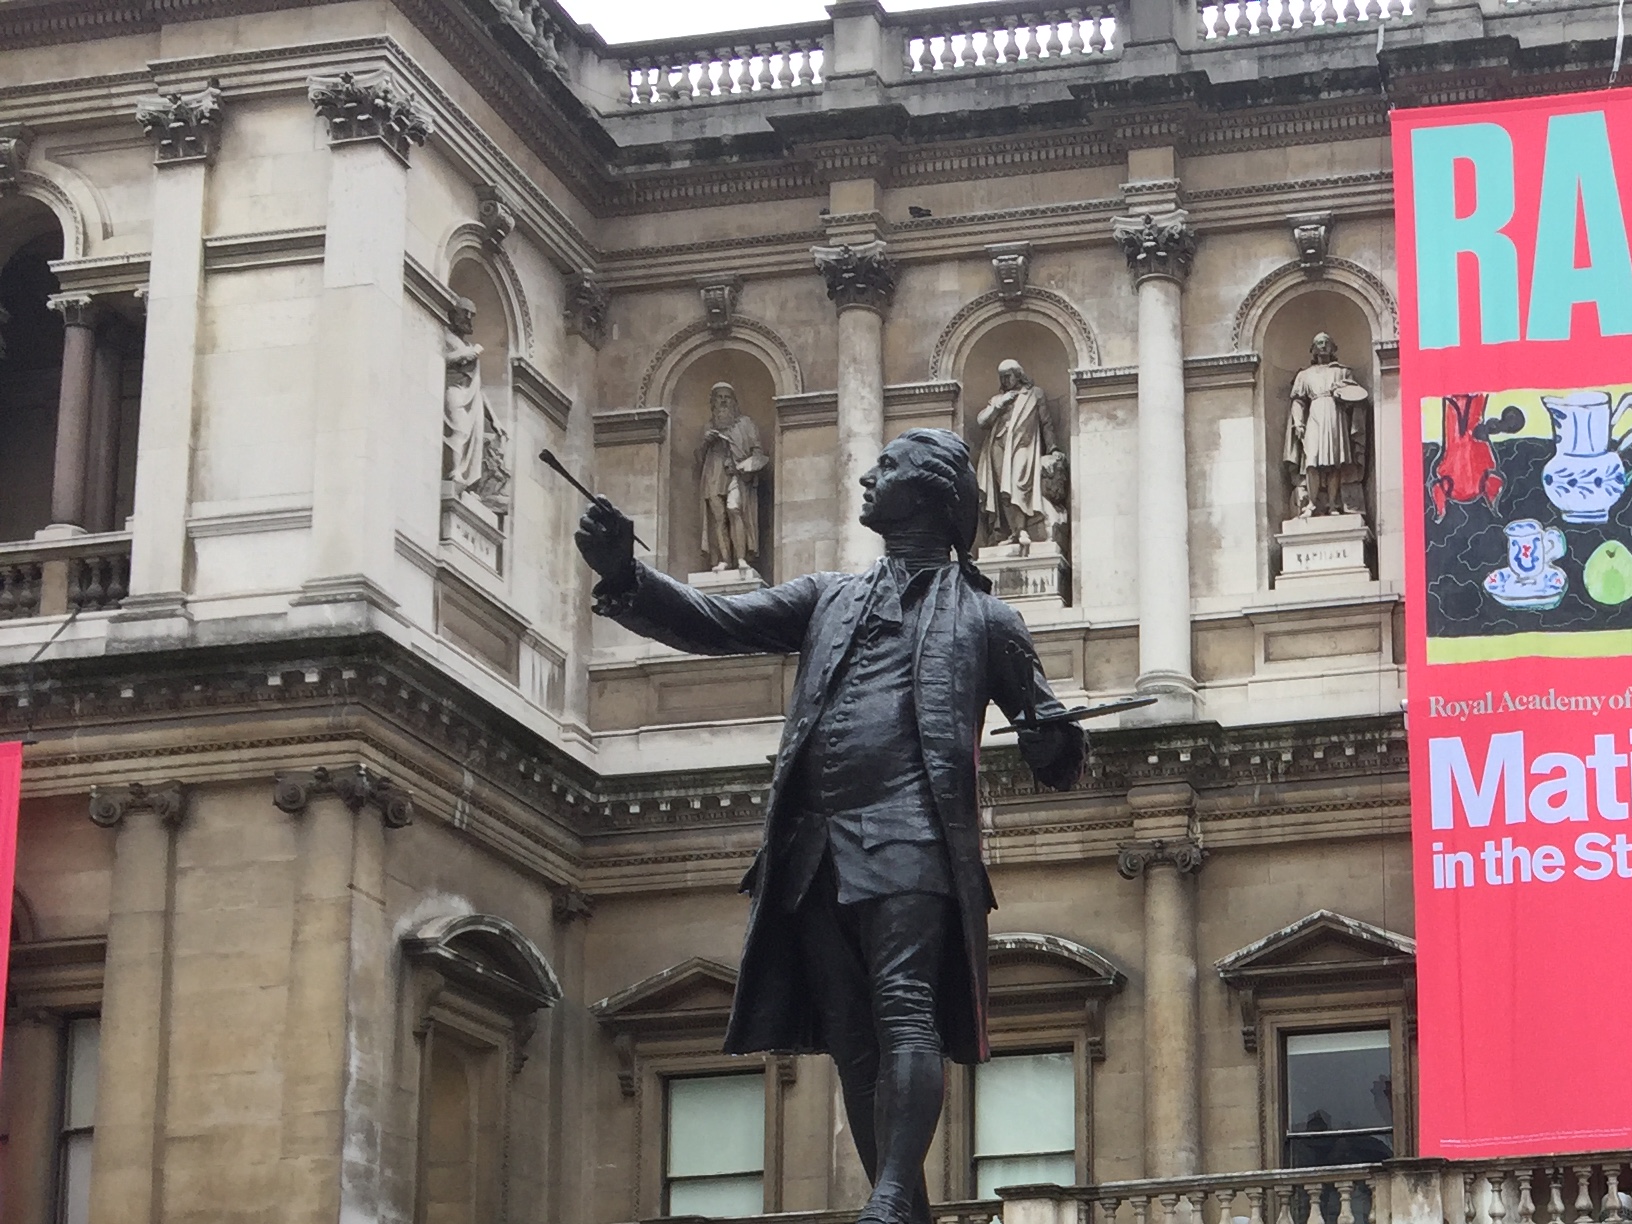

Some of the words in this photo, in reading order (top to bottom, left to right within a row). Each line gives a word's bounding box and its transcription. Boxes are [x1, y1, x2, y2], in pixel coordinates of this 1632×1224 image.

[1429, 692, 1493, 721] Royal
[1497, 688, 1606, 716] Academy
[1432, 842, 1475, 889] in
[1481, 837, 1565, 887] the
